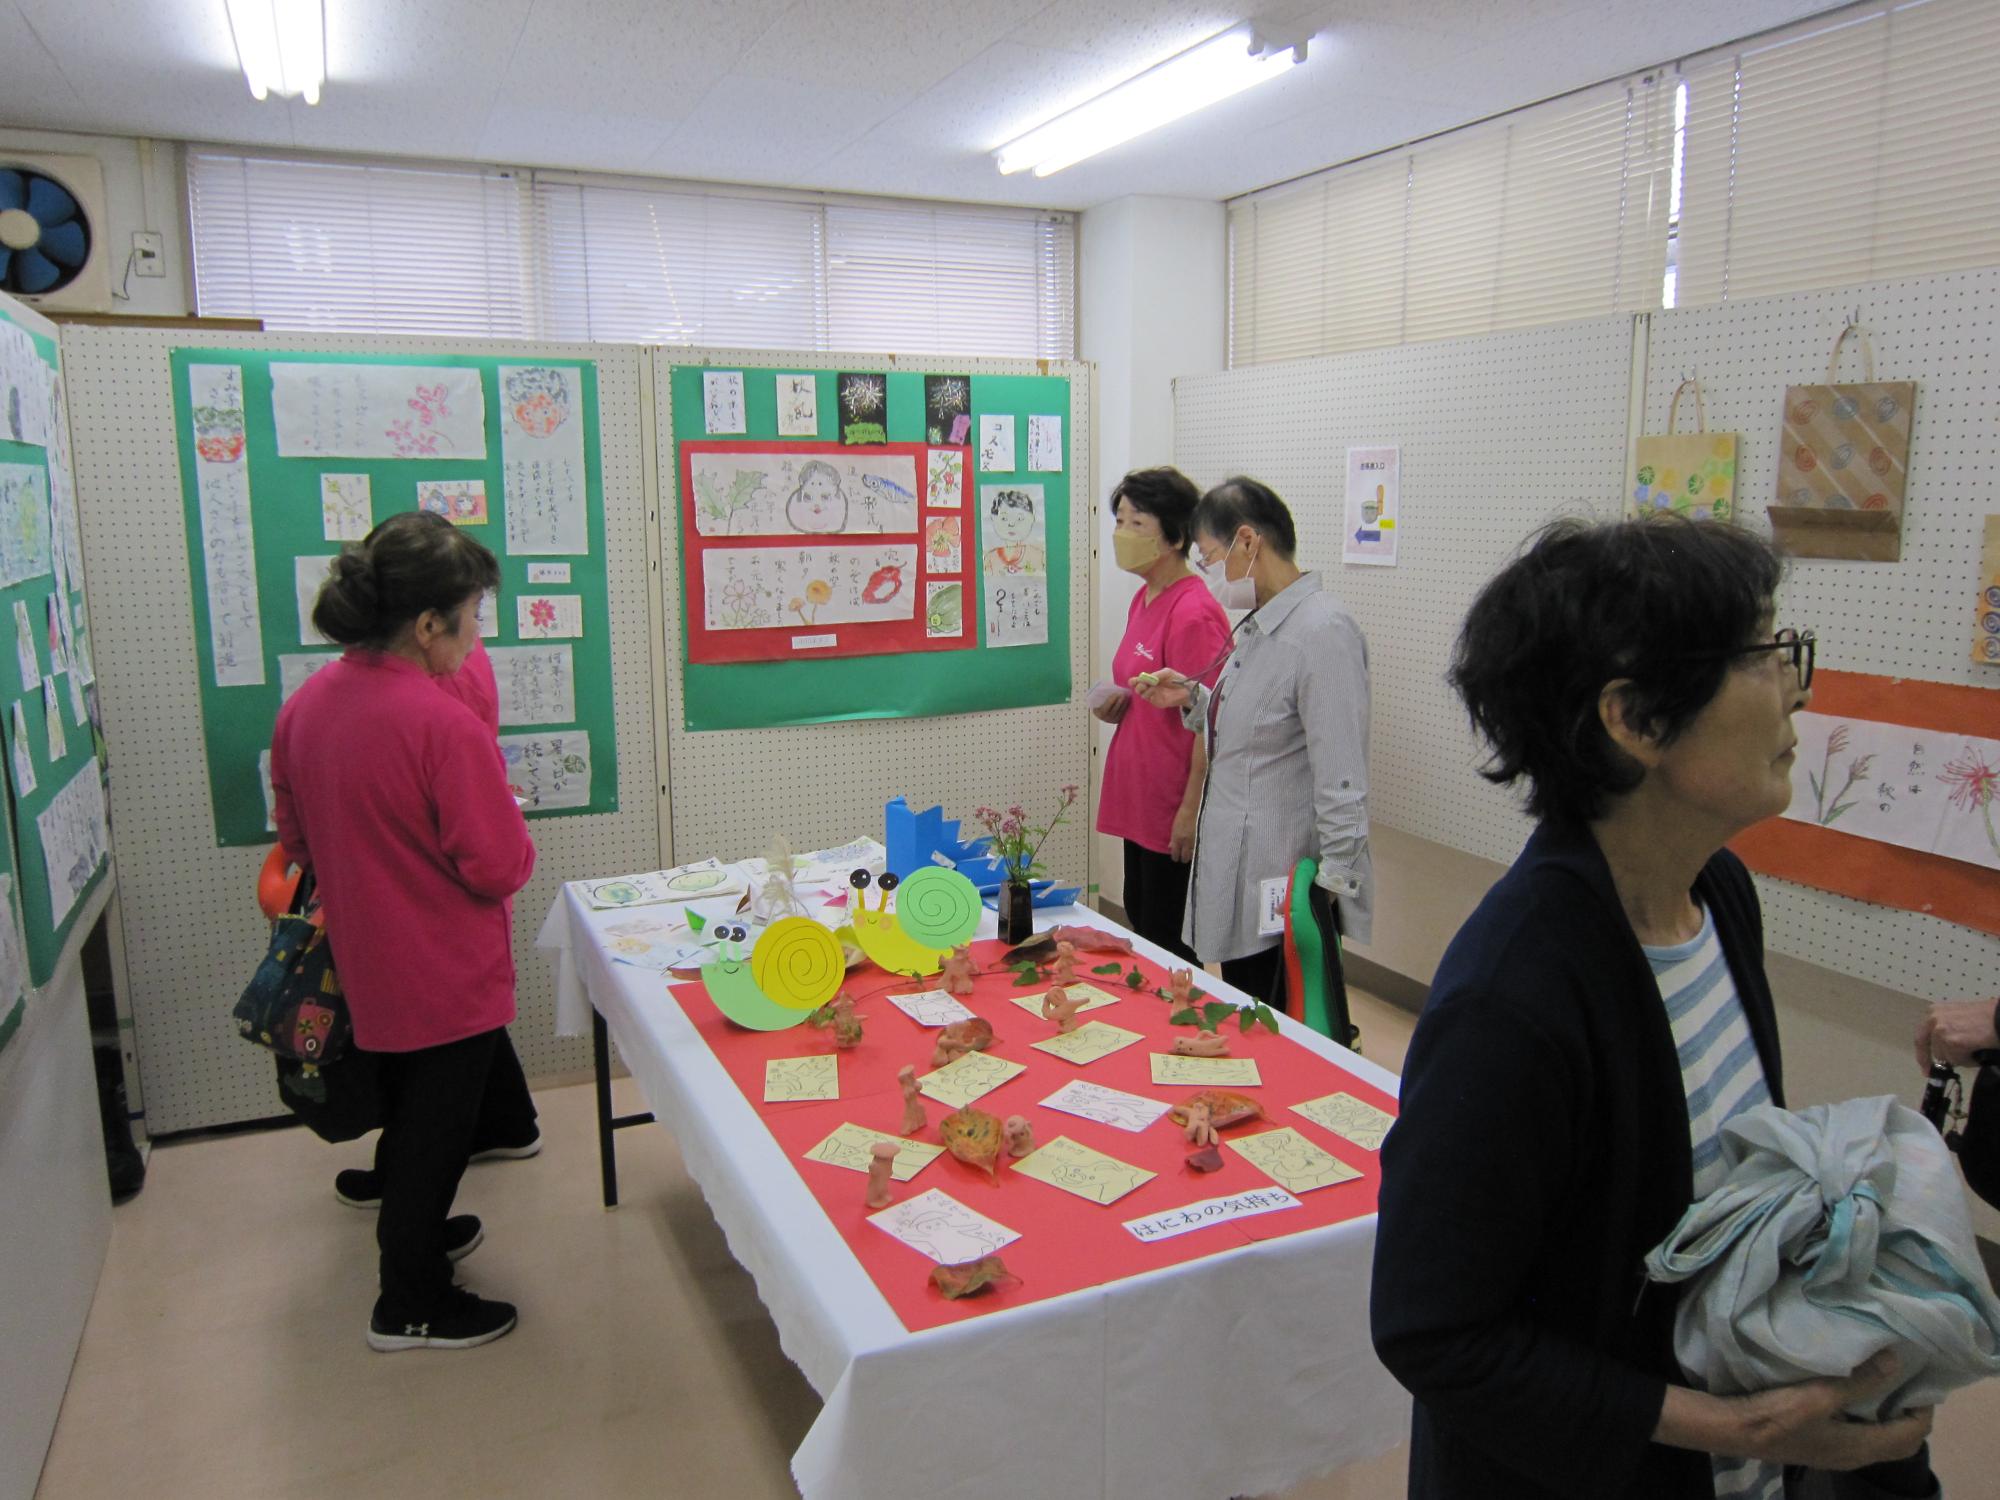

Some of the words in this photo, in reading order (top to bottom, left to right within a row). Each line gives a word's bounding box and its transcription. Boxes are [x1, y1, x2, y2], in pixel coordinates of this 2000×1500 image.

[523, 741, 543, 807] 続いています
[551, 739, 567, 792] 暑い日が
[1132, 1192, 1289, 1238] はにわの気持ち
